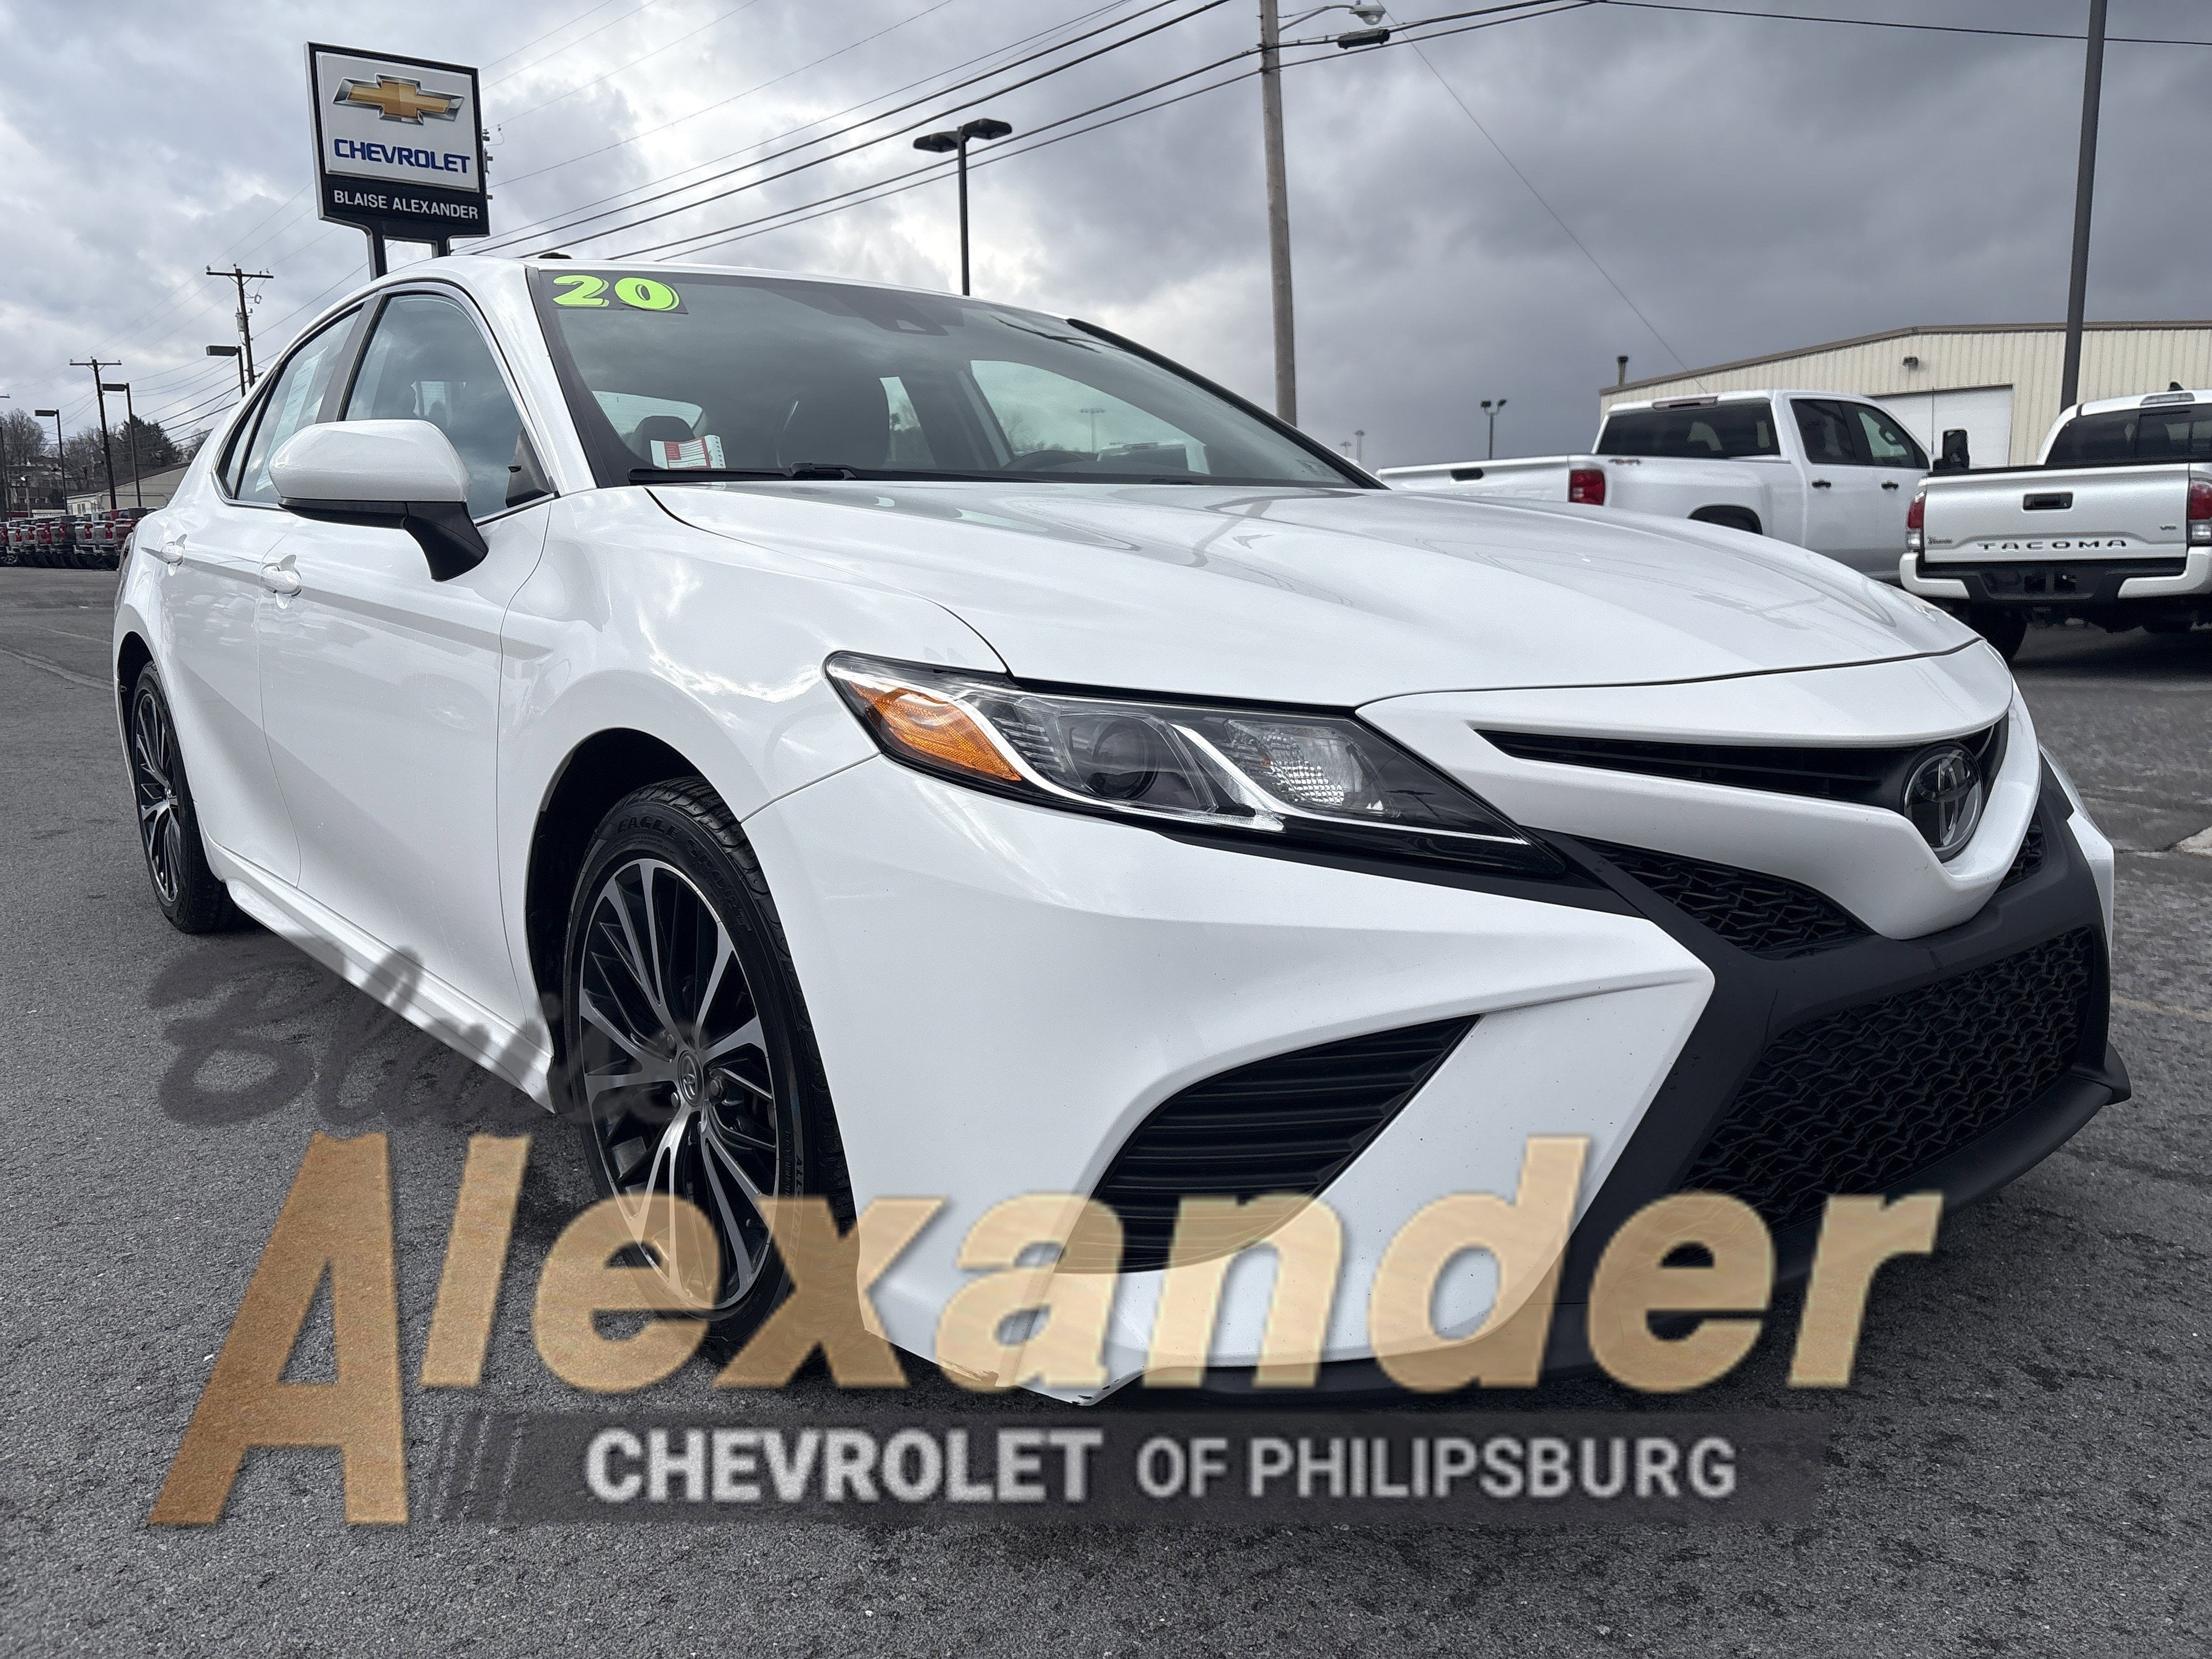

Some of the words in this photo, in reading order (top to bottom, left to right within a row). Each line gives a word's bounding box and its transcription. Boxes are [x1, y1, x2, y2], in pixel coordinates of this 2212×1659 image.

[334, 138, 470, 173] CHEVROLET
[334, 189, 387, 210] BLAISE
[393, 197, 478, 220] ALEXANDER
[552, 274, 680, 311] 20
[1977, 539, 2127, 553] TACOMA
[617, 815, 683, 840] EAGLE
[685, 838, 753, 932] SPORT
